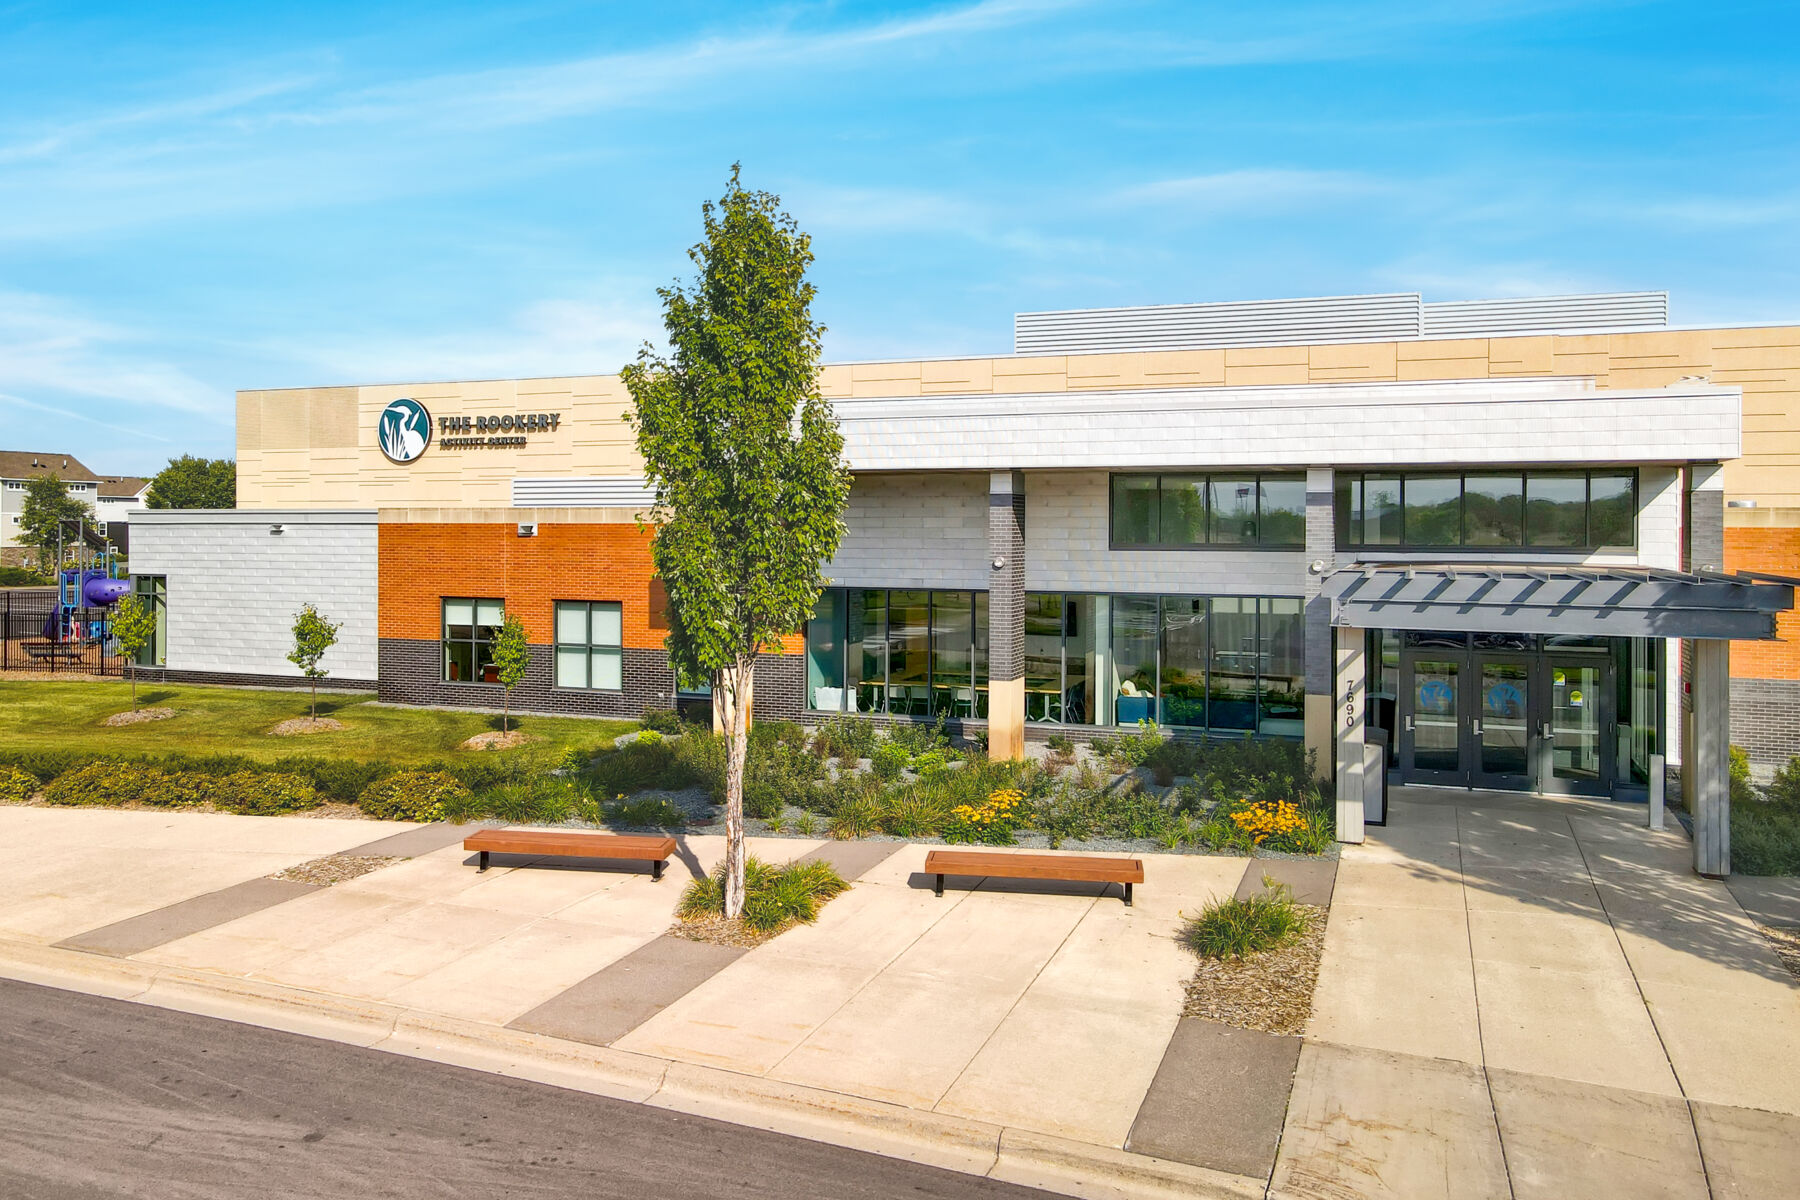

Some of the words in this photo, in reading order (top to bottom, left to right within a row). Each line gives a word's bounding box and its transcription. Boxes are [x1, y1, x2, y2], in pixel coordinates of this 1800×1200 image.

[438, 416, 471, 431] THE
[476, 413, 561, 431] ROOKERY
[440, 437, 485, 447] ACTIVITY
[487, 436, 527, 446] CENTER
[1346, 680, 1354, 727] 7690
